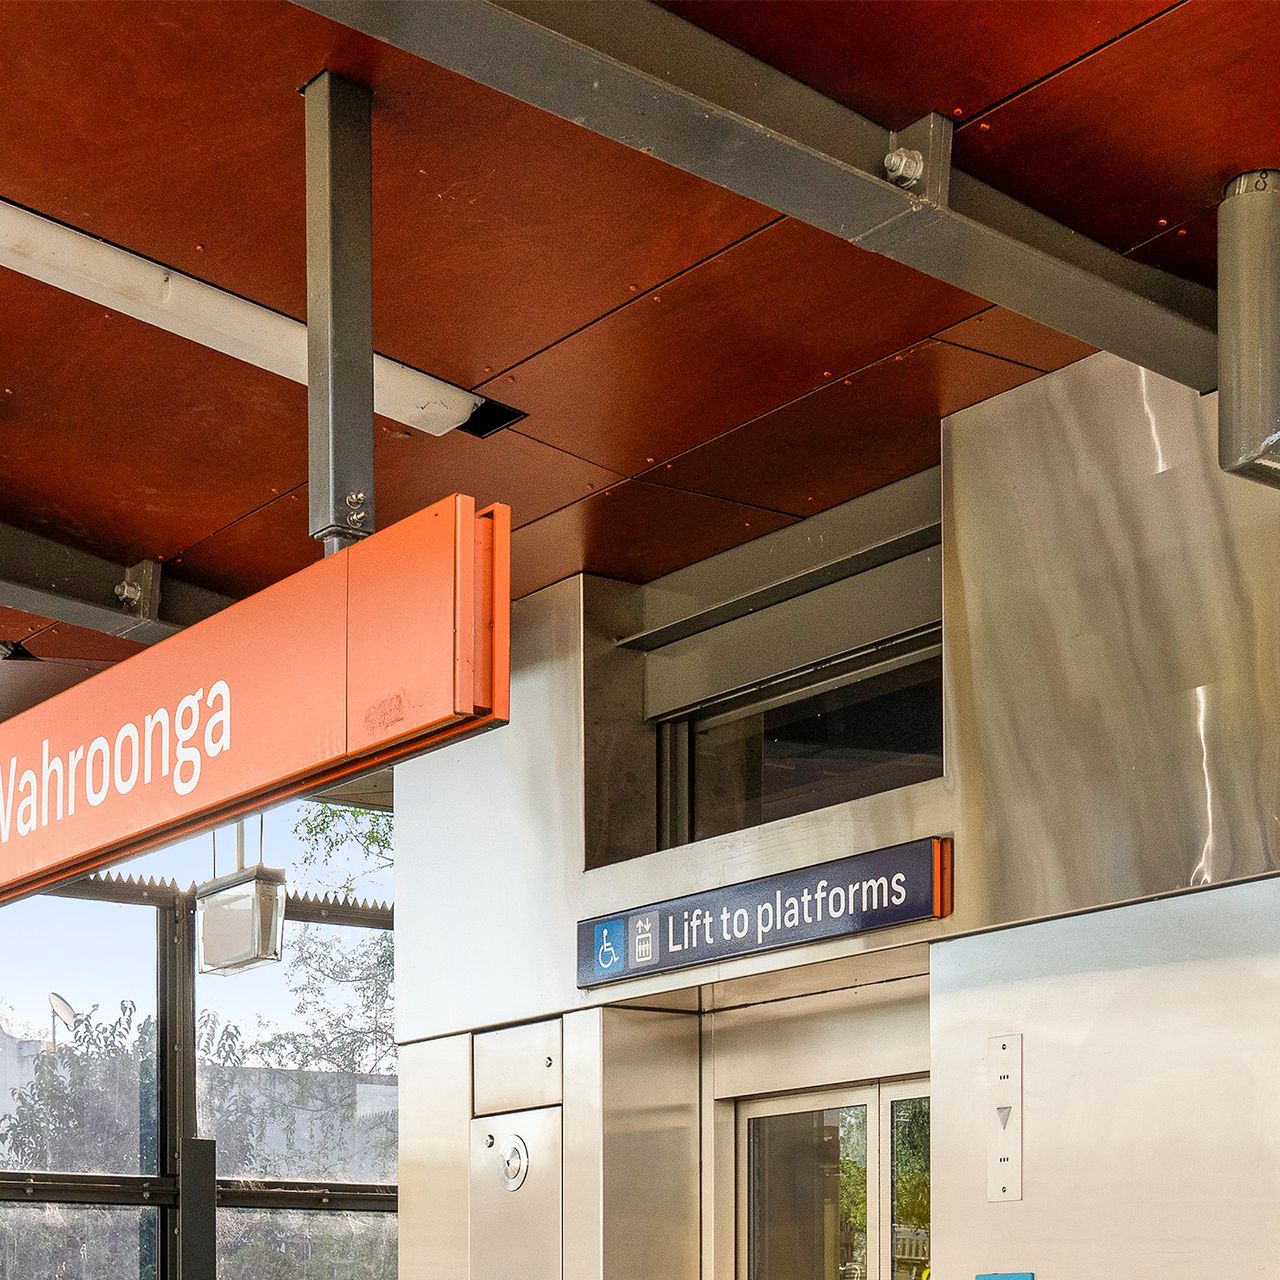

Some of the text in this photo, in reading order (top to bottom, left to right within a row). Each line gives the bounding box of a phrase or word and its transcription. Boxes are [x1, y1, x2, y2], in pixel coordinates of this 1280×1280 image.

[668, 872, 907, 953] Lift to platforms
